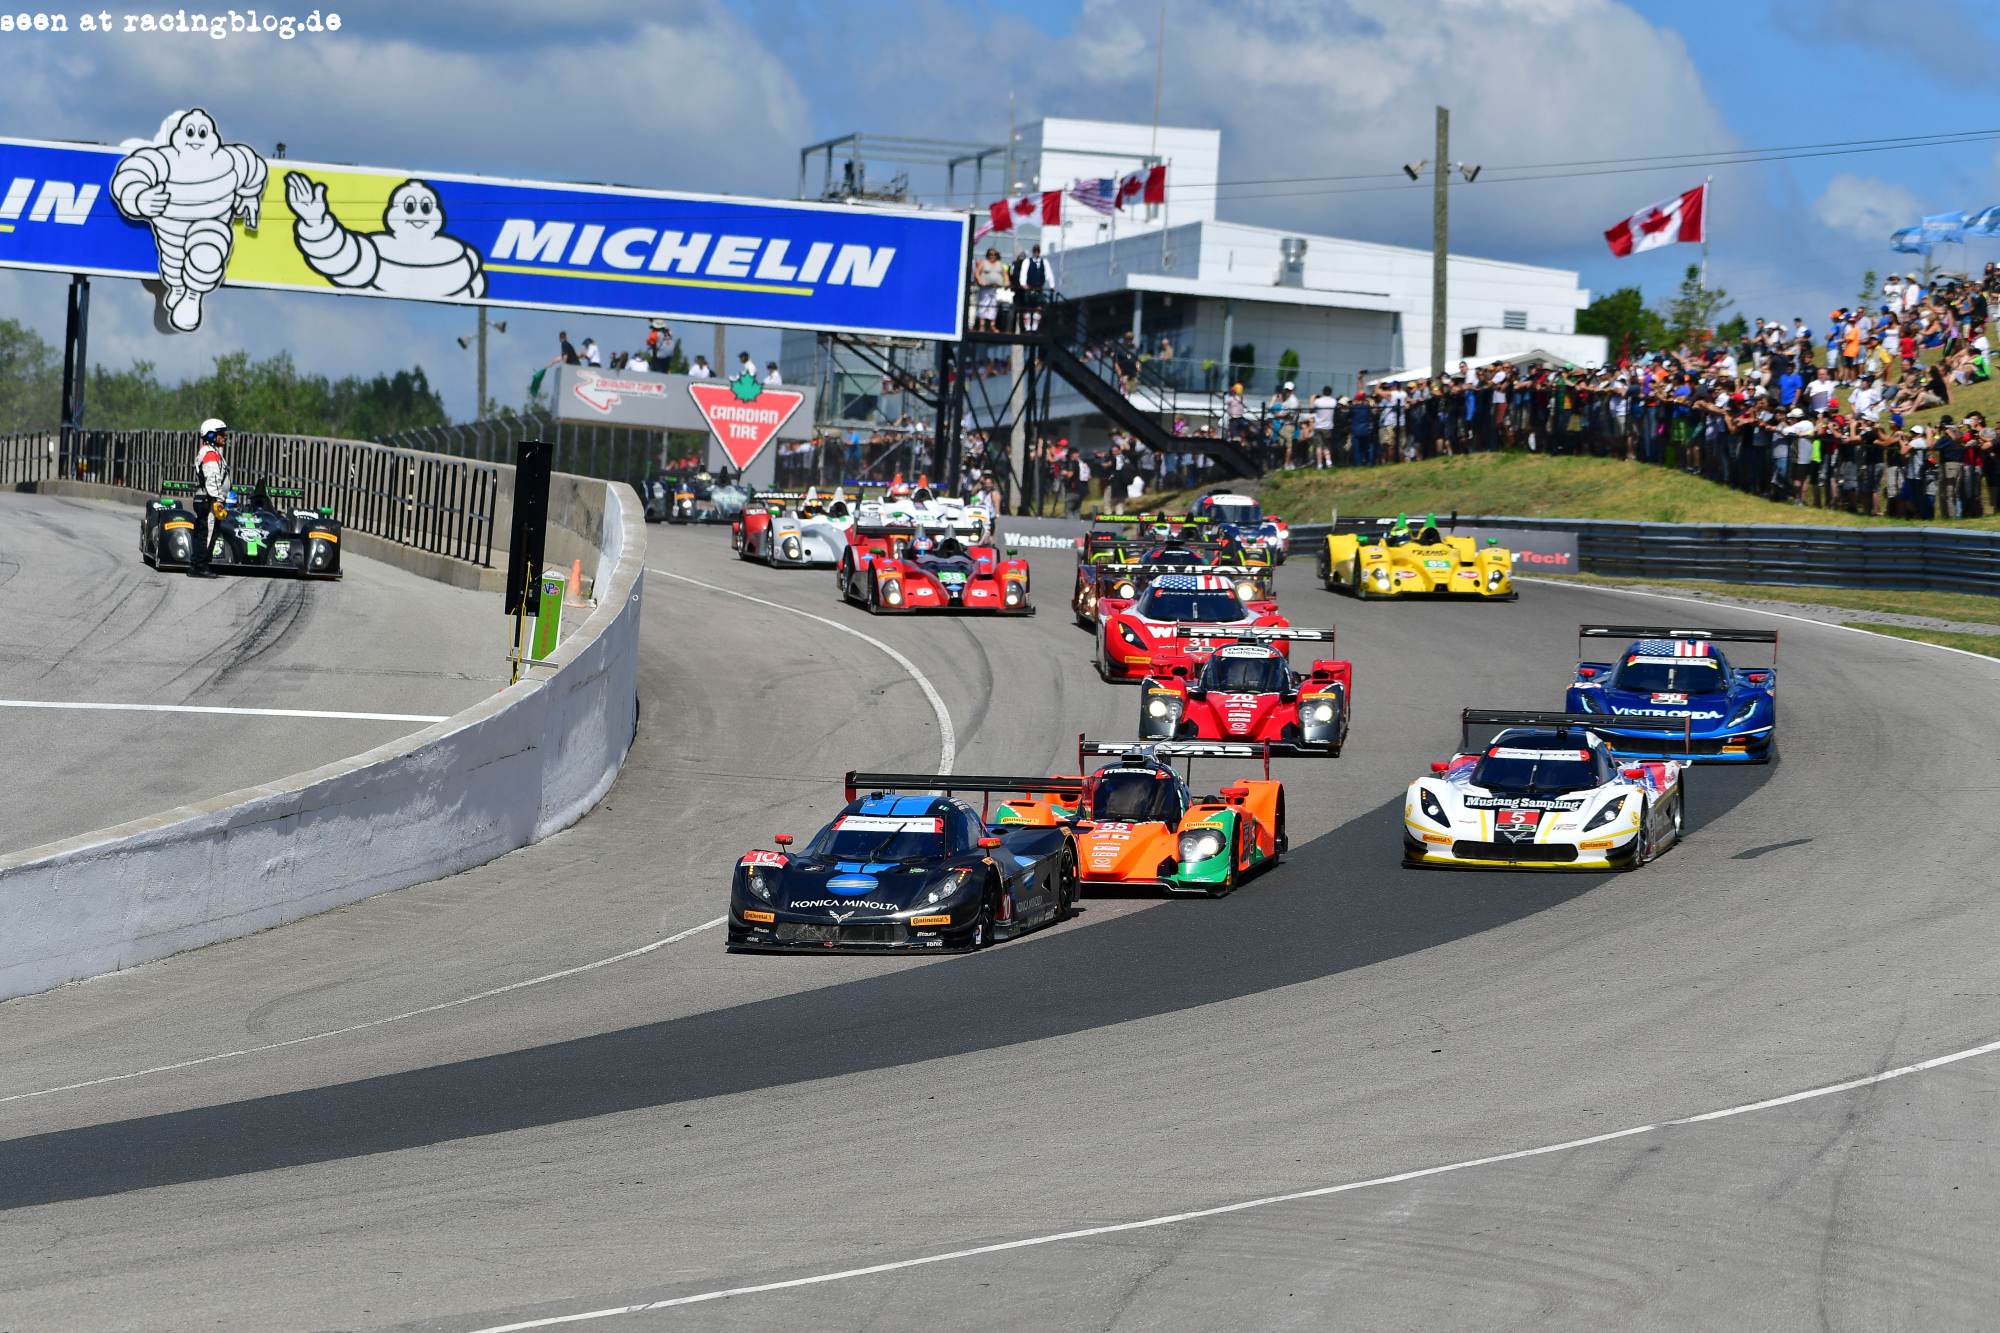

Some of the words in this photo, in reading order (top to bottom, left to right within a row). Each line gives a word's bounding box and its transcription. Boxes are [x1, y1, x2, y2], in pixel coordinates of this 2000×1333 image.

[490, 219, 896, 288] MICHELIN
[710, 405, 779, 424] CANADIAN
[728, 424, 758, 441] TIRE
[943, 572, 961, 581] 38
[1189, 638, 1209, 647] 31
[1465, 797, 1519, 808] Mustang
[1520, 798, 1580, 812] Sampling
[1510, 811, 1526, 823] 5
[753, 852, 778, 863] 10
[790, 900, 840, 908] KONICA
[843, 900, 899, 911] MINOLTA
[912, 917, 943, 925] Continental
